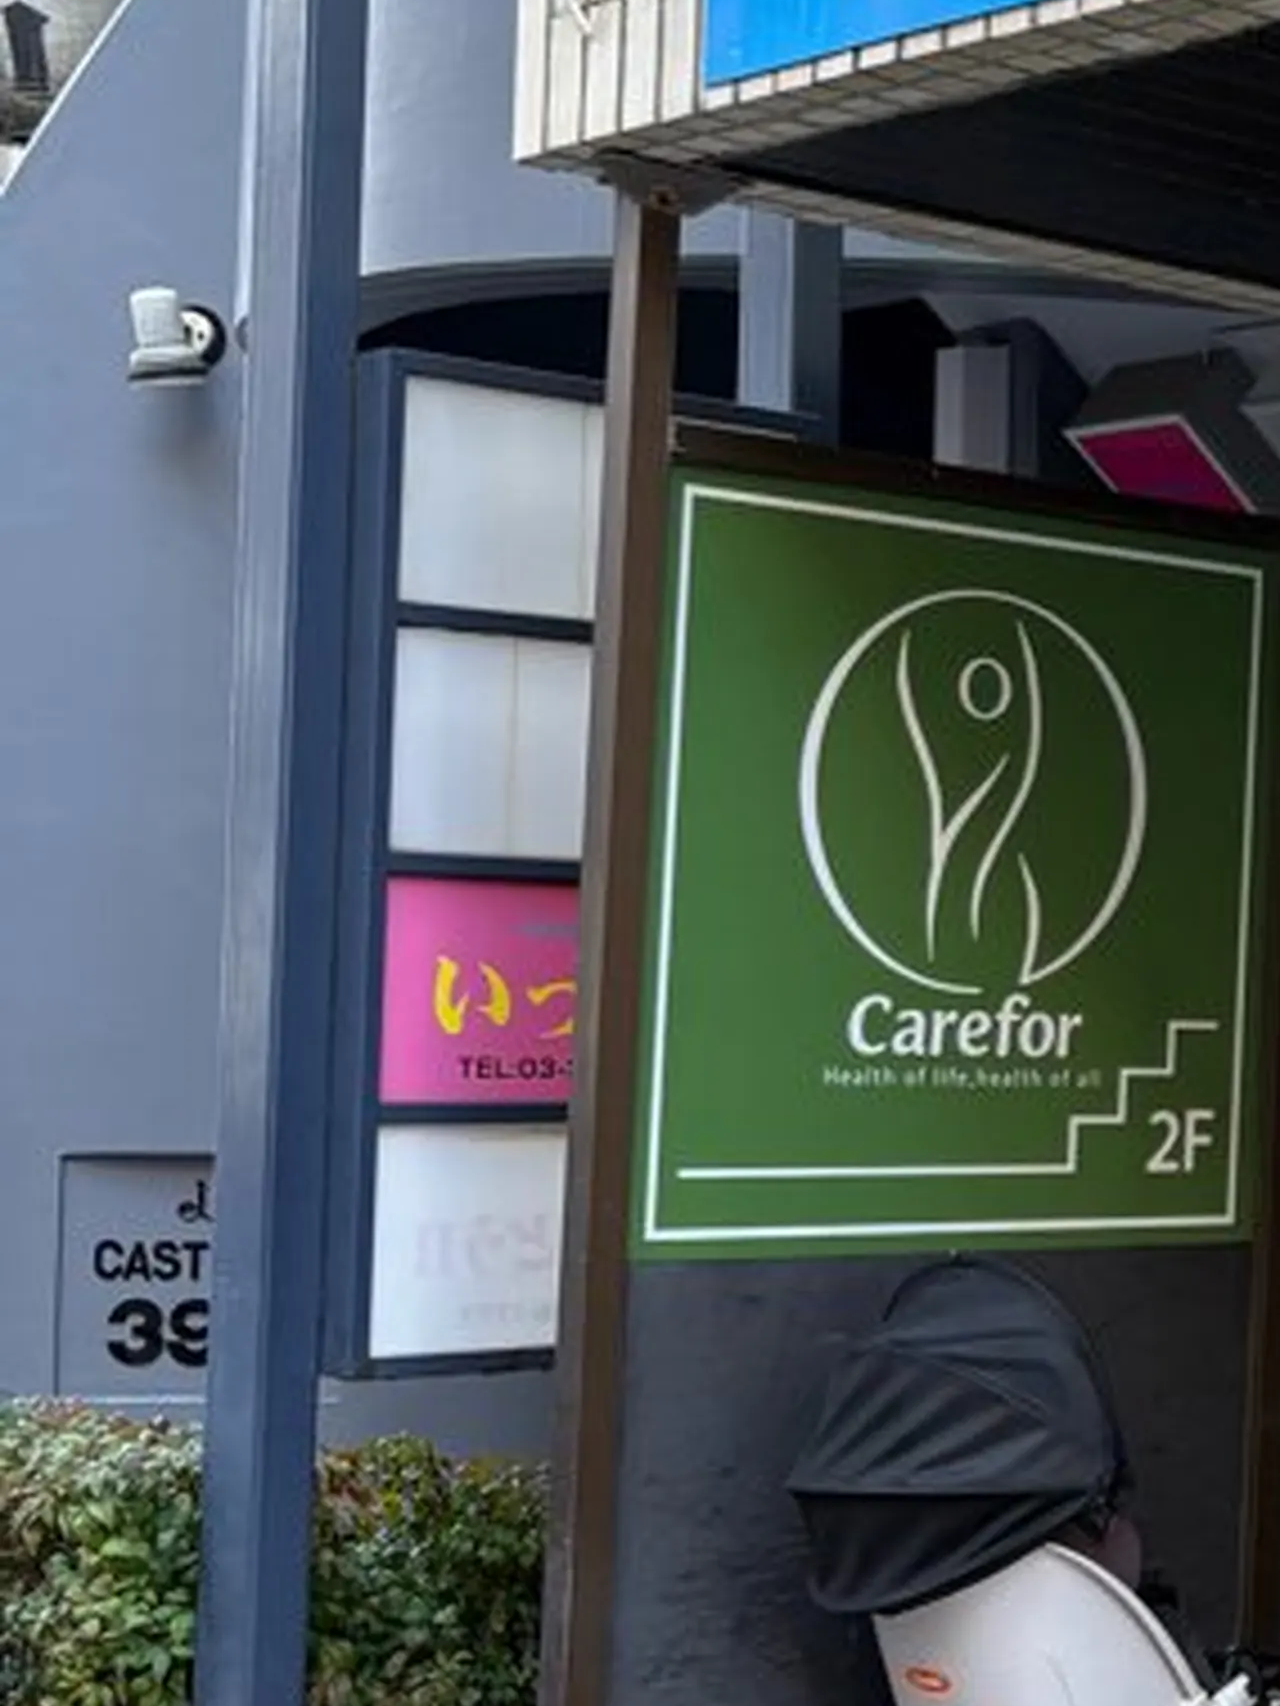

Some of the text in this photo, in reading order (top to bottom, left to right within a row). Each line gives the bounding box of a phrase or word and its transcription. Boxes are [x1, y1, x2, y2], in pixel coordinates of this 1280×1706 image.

[846, 993, 1084, 1059] Carefor
[823, 1064, 897, 1087] Health
[904, 1066, 928, 1087] of
[1049, 1066, 1071, 1088] of
[1077, 1069, 1099, 1089] all
[1145, 1109, 1217, 1173] 2F
